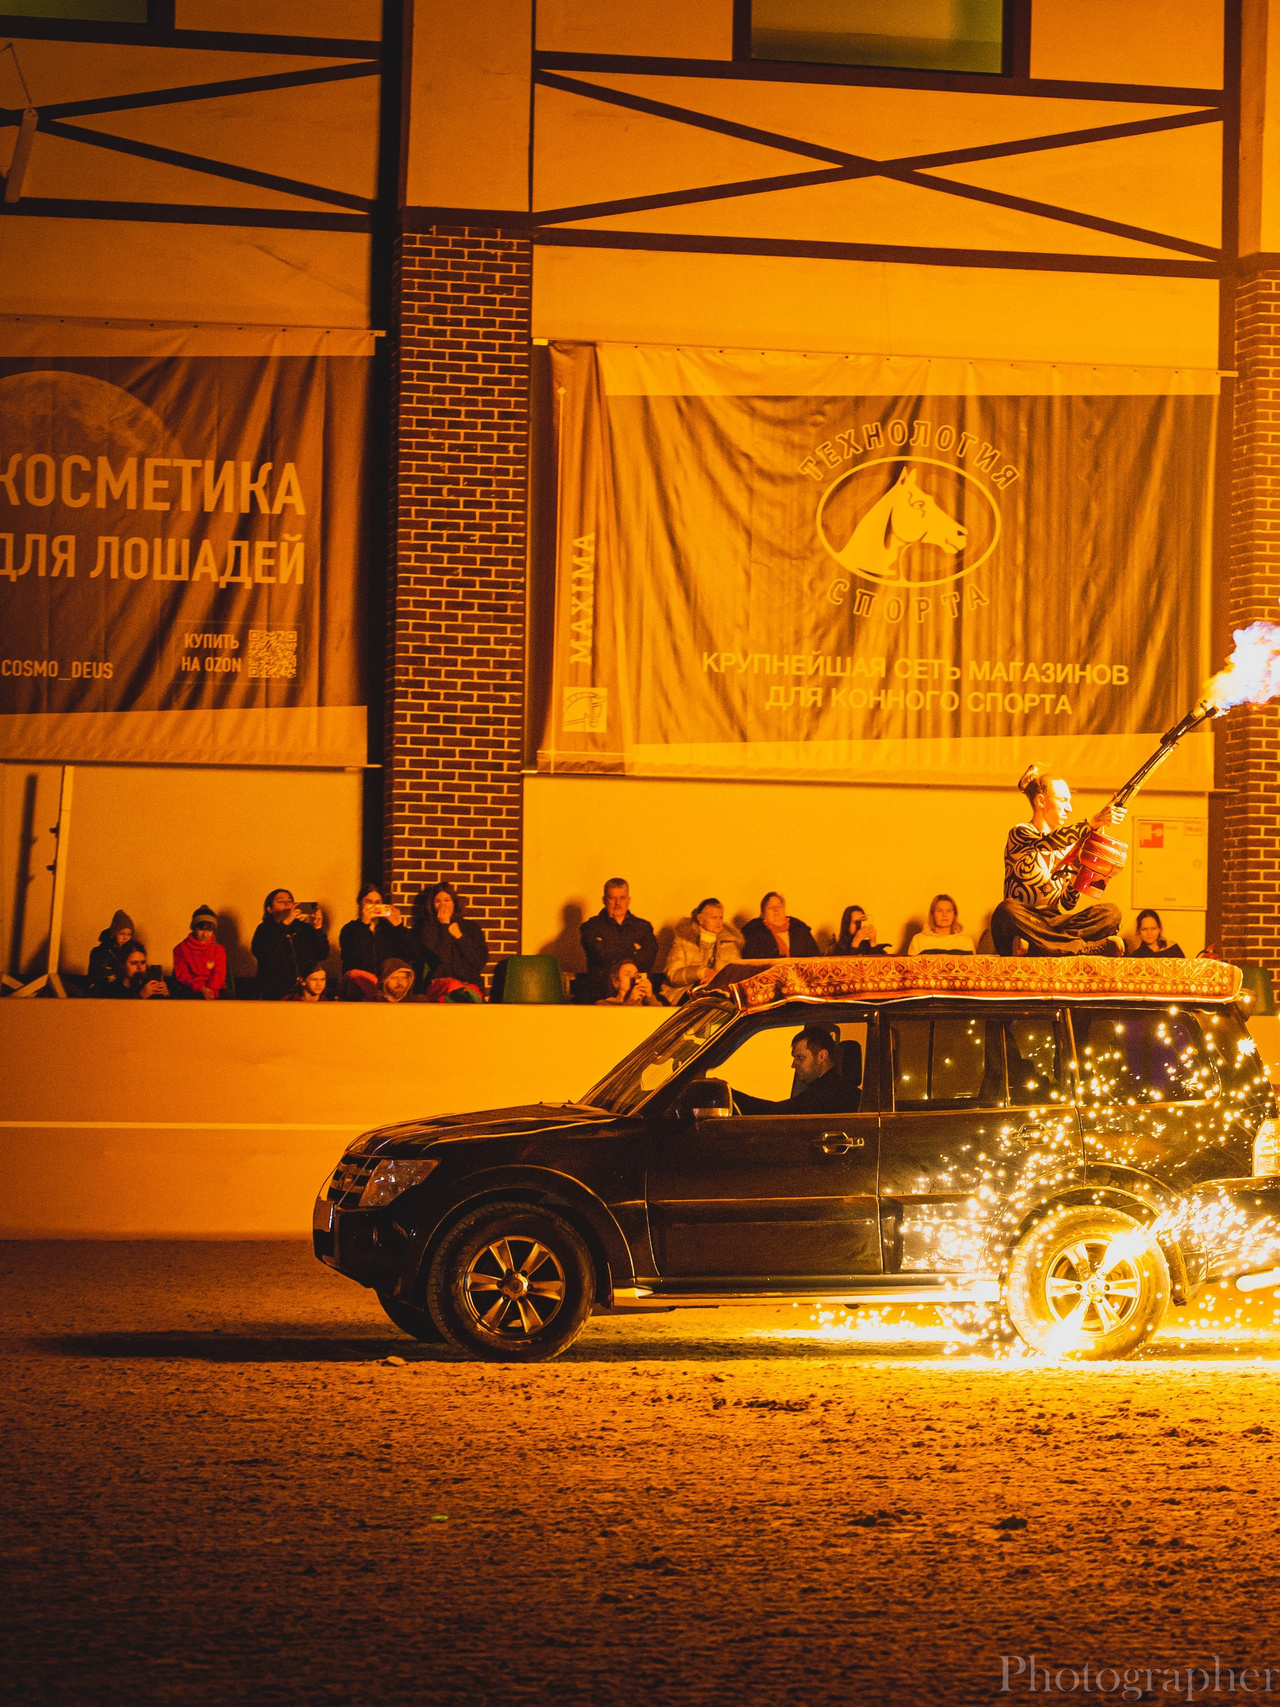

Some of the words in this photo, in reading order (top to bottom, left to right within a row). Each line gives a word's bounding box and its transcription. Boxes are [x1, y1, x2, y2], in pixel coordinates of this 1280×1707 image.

[798, 419, 1020, 490] ТЕХНОЛОГИЯ
[90, 534, 304, 589] ЛОШАДЕЙ
[570, 531, 595, 665] MAXIMA
[826, 578, 990, 624] СПОРТА
[185, 633, 239, 649] КУПИТЬ
[182, 656, 200, 671] НА
[205, 657, 242, 673] OZON
[702, 651, 886, 678] КРУПНЕЙШАЯ
[893, 657, 961, 680] СЕТЬ
[969, 660, 1129, 685] МАГАЗИНОВ
[766, 685, 823, 711] ДЛЯ
[830, 687, 960, 712] КОННОГО
[966, 690, 1072, 714] СПОРТА
